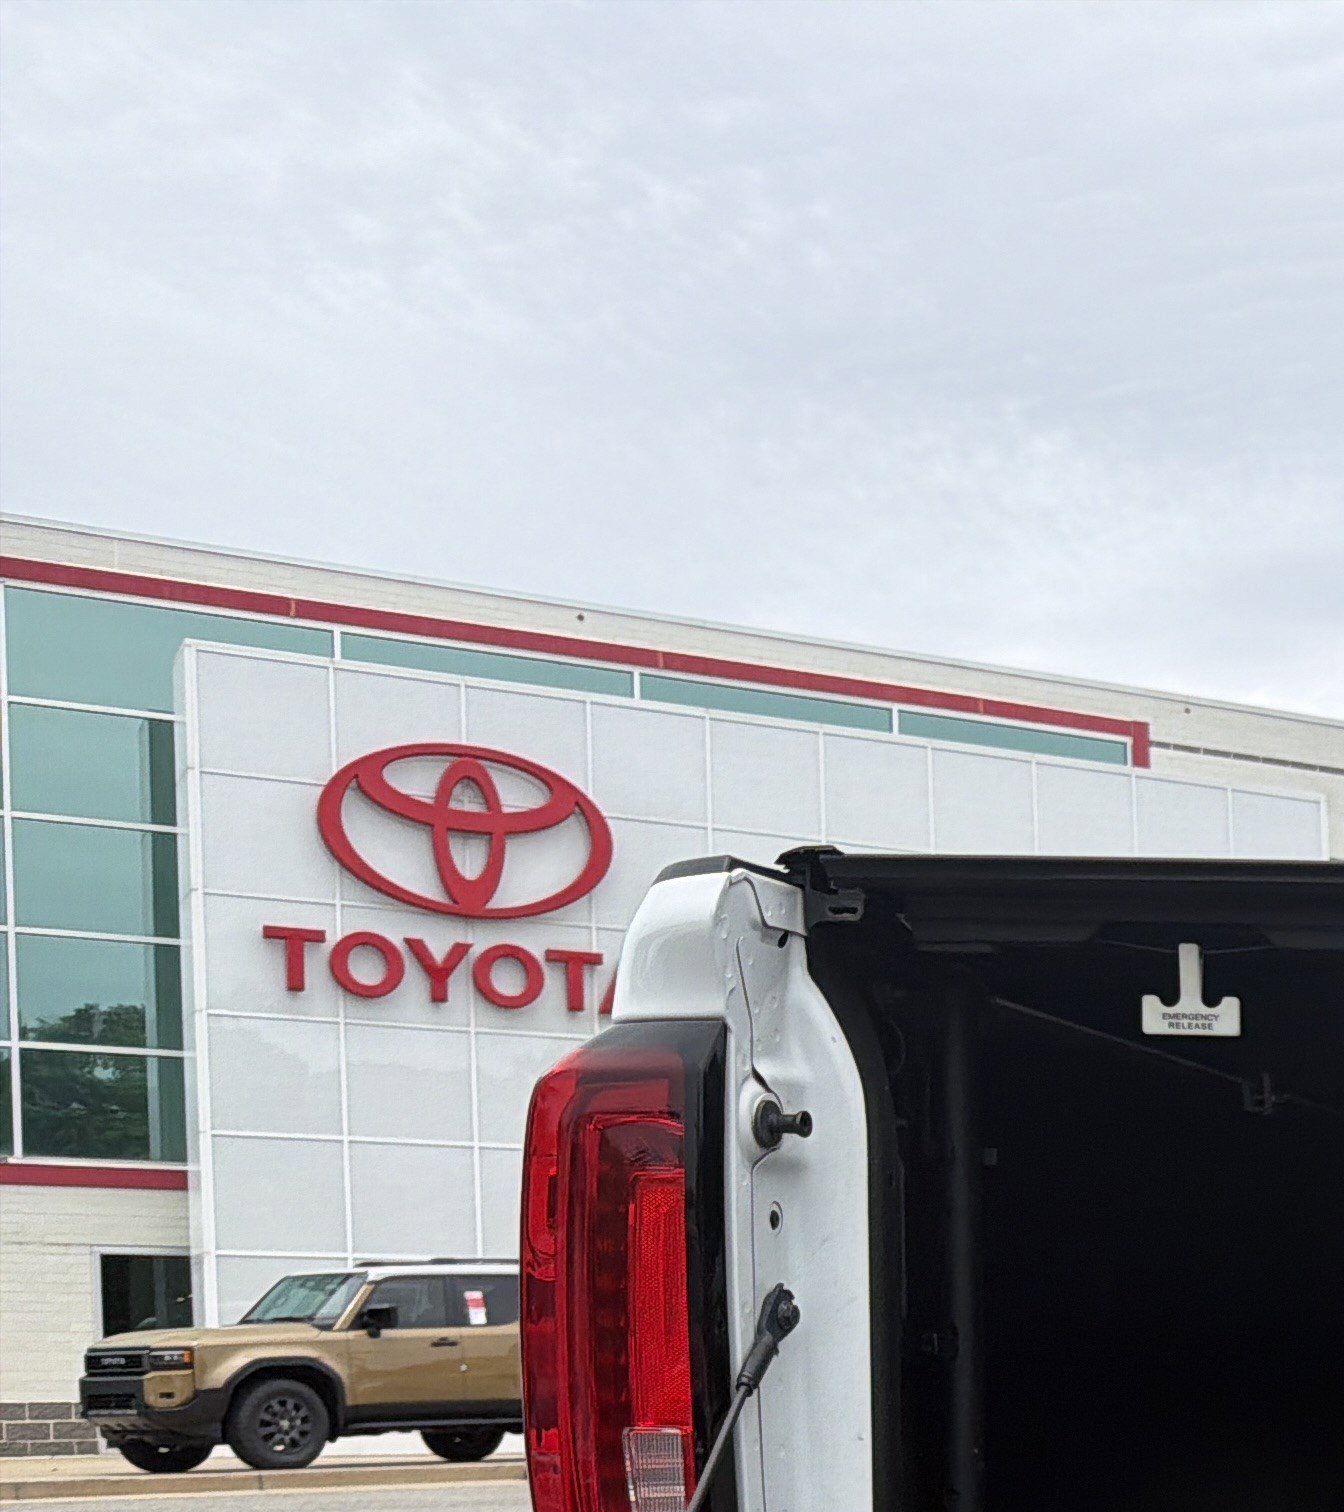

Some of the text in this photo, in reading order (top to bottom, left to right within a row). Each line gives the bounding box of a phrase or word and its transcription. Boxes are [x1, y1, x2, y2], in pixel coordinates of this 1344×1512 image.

[262, 925, 617, 1014] TOYOT
[1162, 1013, 1219, 1021] EMERGENCY
[1168, 1022, 1213, 1030] RELEASE
